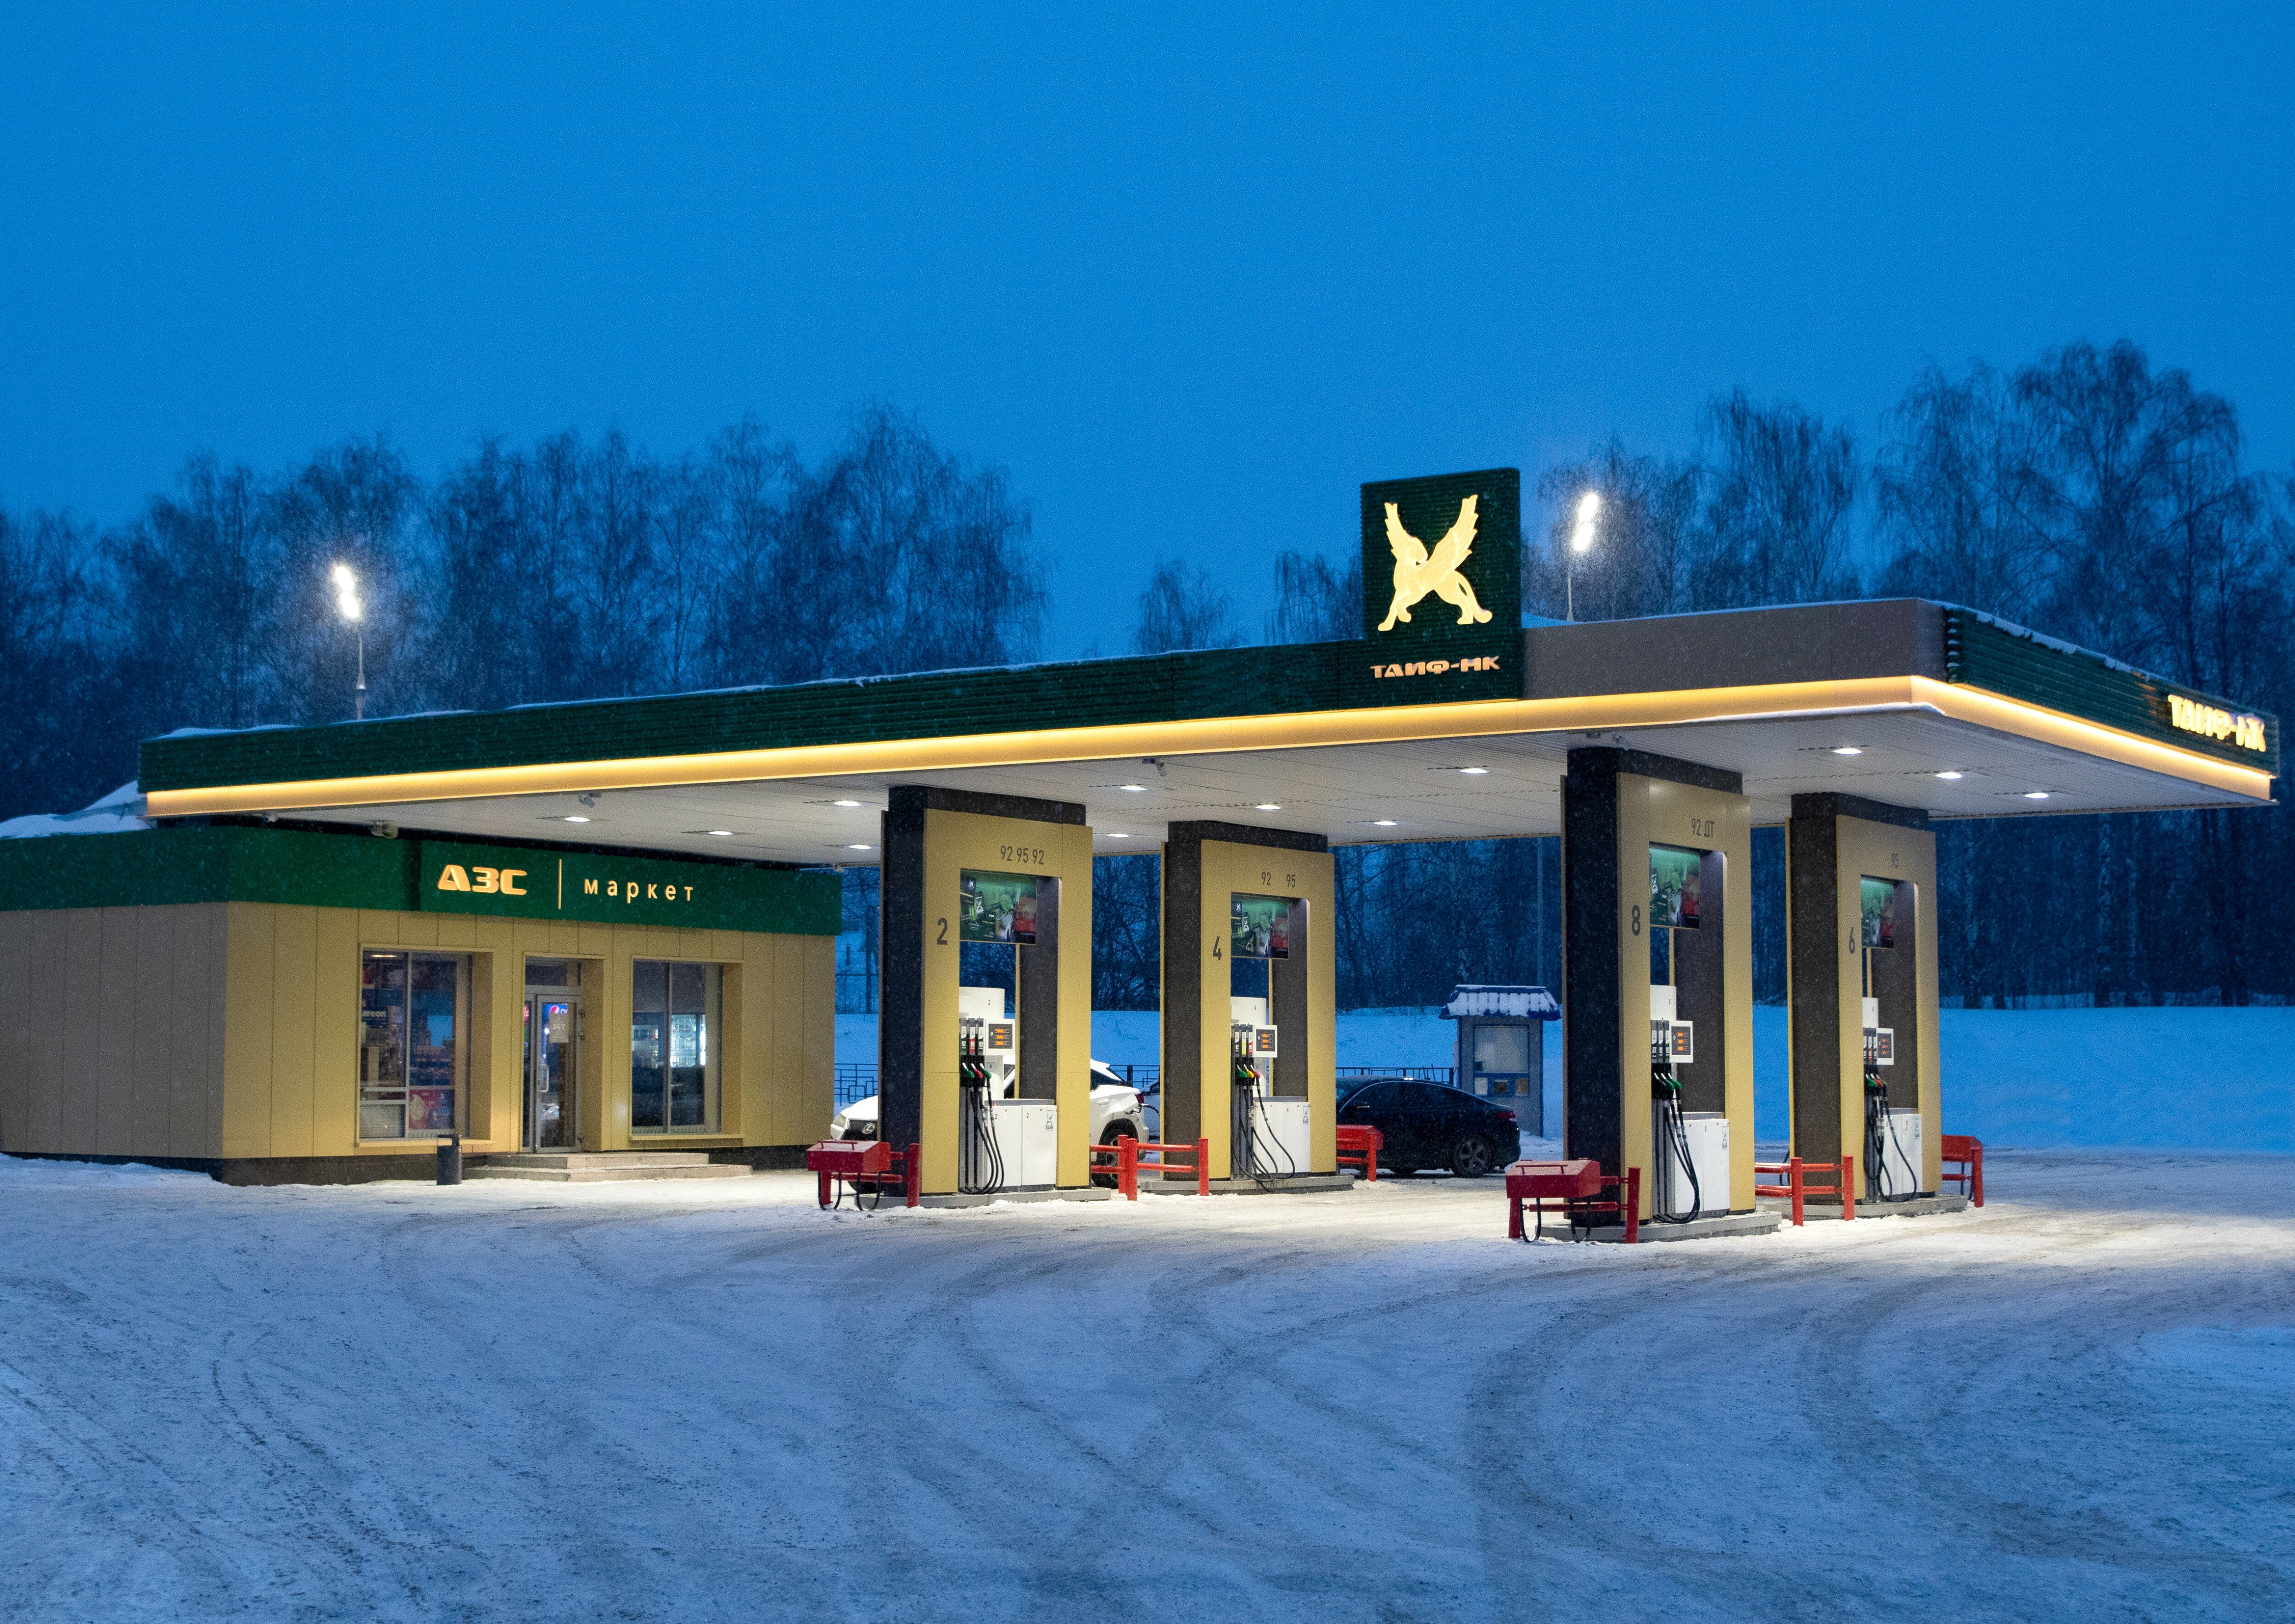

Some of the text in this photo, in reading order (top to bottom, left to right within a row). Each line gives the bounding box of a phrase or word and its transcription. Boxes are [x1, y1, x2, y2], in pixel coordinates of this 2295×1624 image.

[1370, 656, 1500, 678] ТАИФ-НК
[1691, 818, 1715, 838] 92 ДТ
[1000, 845, 1044, 865] 92 95 92
[437, 864, 694, 904] АЗС маркет
[1261, 872, 1296, 888] 92 95
[937, 918, 948, 945] 2
[1632, 904, 1640, 936] 8
[1212, 936, 1222, 961] 4
[1848, 927, 1855, 954] 6
